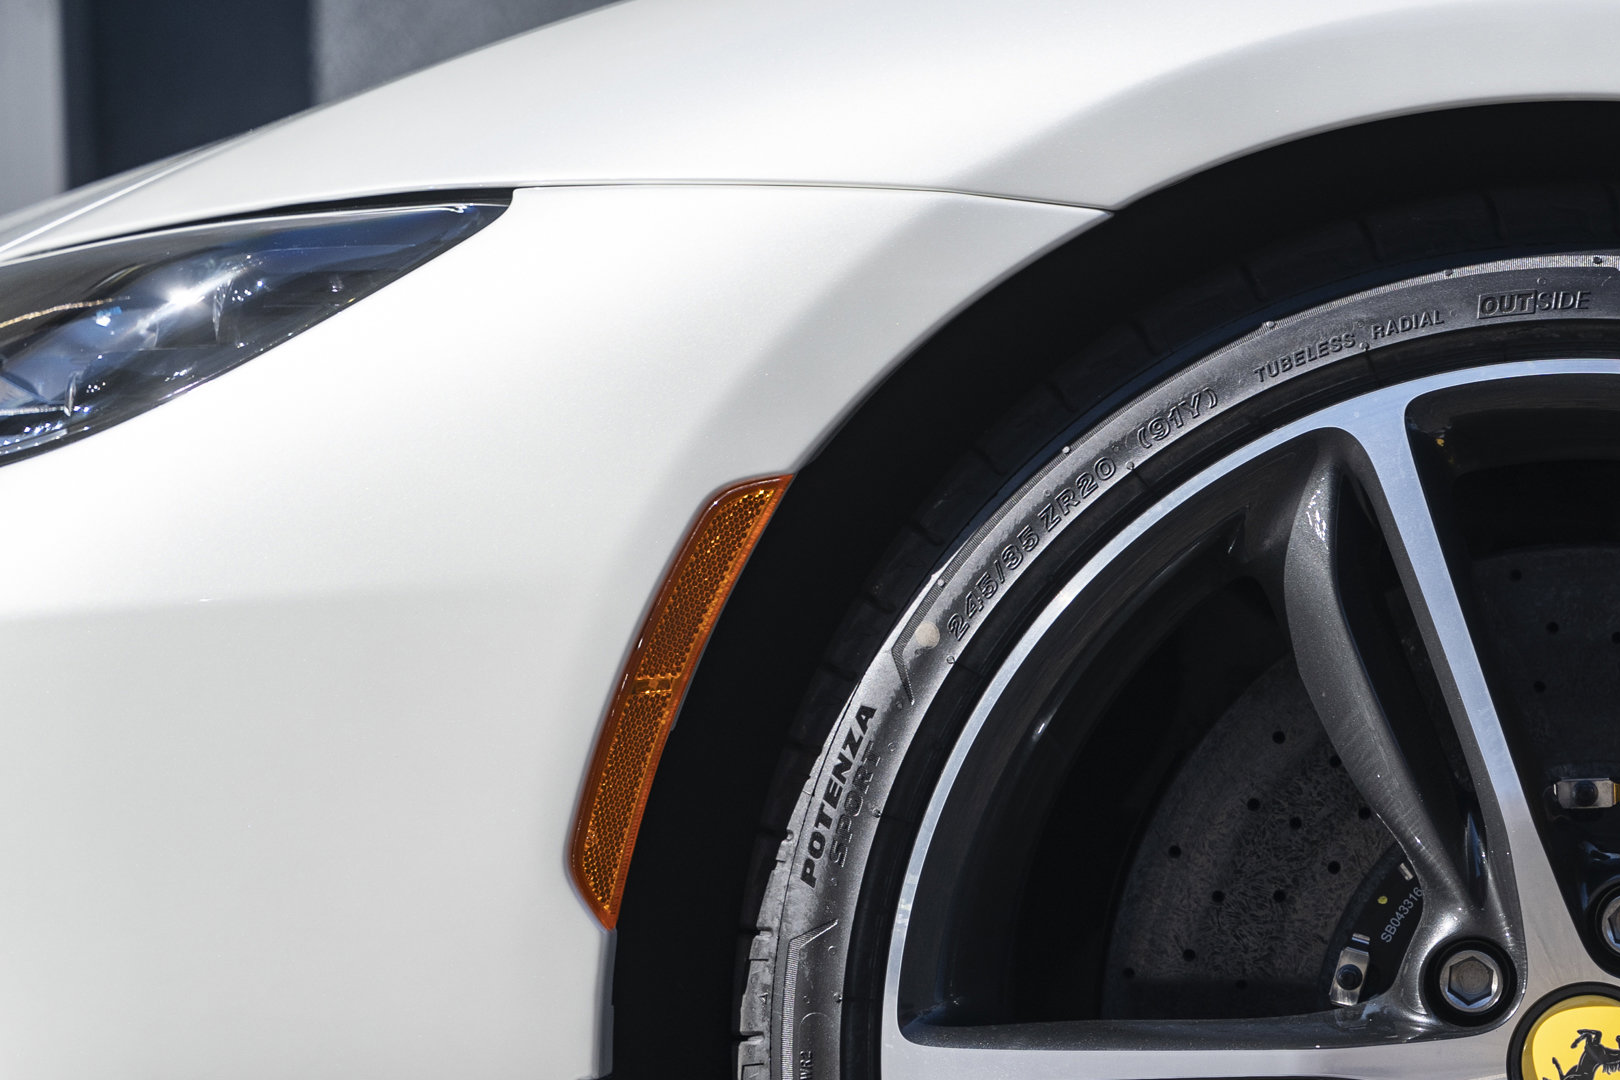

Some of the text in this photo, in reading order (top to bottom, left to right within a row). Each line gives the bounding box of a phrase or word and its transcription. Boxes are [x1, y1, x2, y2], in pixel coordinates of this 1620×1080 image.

[1253, 308, 1446, 385] TUBELESS RADIAL
[1480, 289, 1591, 317] OUTSIDE
[946, 524, 1042, 641] 245/35
[1040, 457, 1119, 532] ZR20
[800, 705, 877, 889] POTENZA
[829, 740, 880, 868] SPORT
[1381, 887, 1424, 943] SB043316
